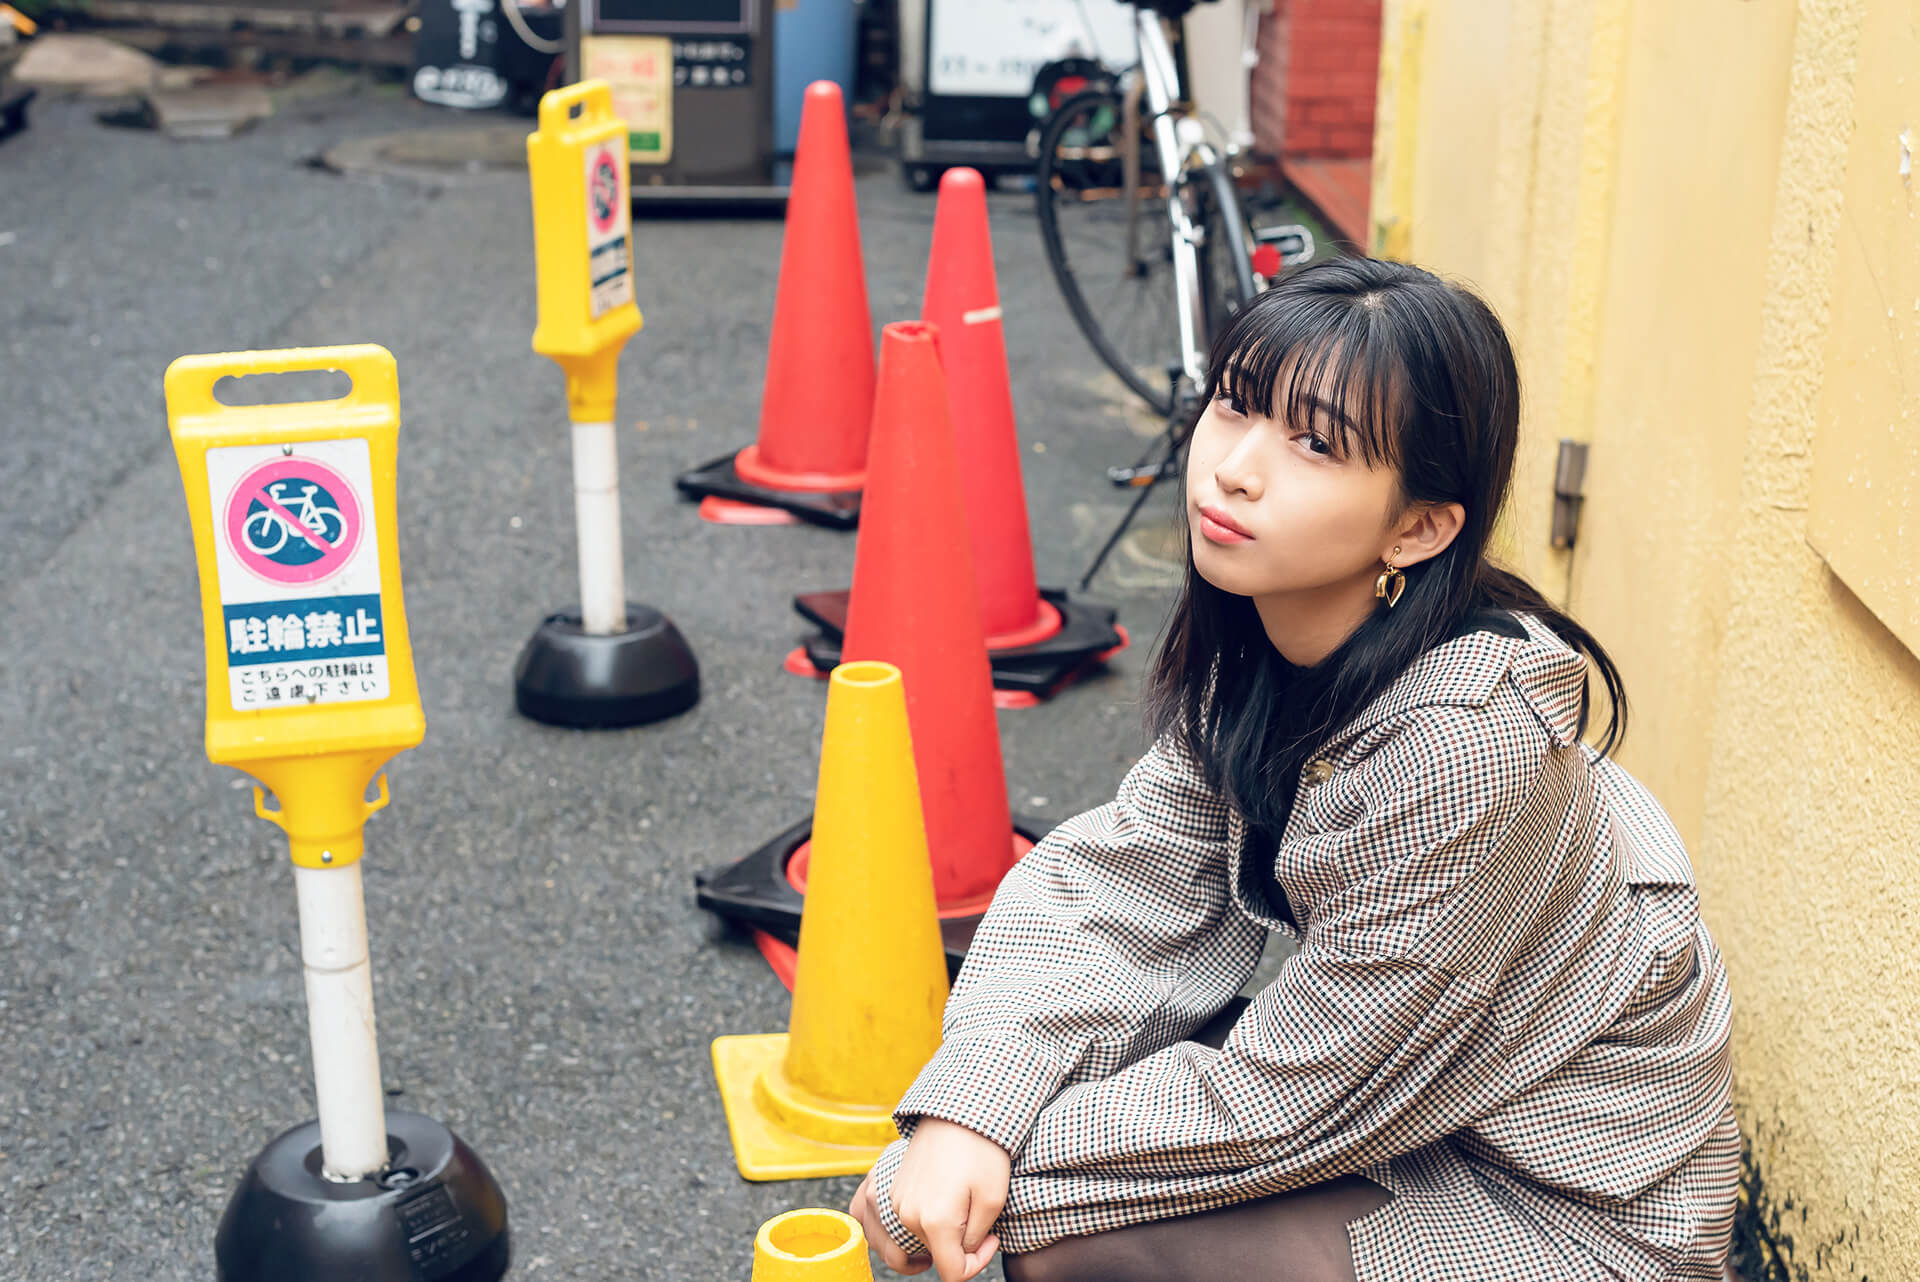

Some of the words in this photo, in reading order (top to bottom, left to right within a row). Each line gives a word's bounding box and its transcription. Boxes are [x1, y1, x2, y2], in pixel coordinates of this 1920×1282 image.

[229, 609, 380, 654] 駐輪禁止
[242, 661, 373, 685] こちらへの駐輪は
